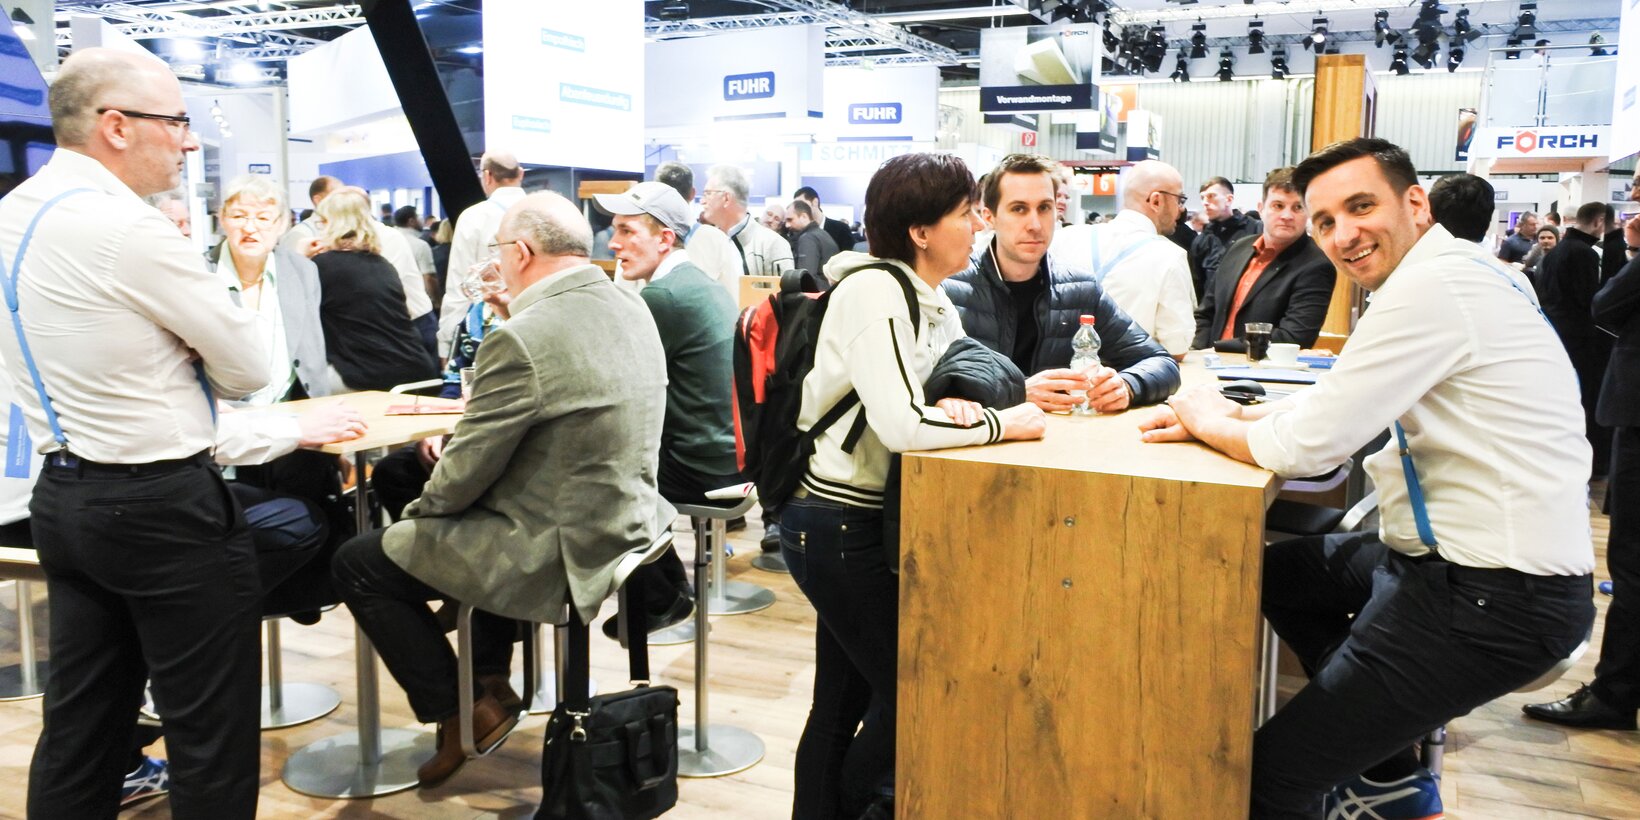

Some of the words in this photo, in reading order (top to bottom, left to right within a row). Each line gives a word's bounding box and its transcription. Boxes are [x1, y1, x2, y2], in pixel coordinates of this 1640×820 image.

[728, 77, 770, 95] FUHR
[997, 95, 1072, 104] Vorwandmontage
[853, 107, 897, 121] FUHR
[1100, 174, 1109, 192] 6
